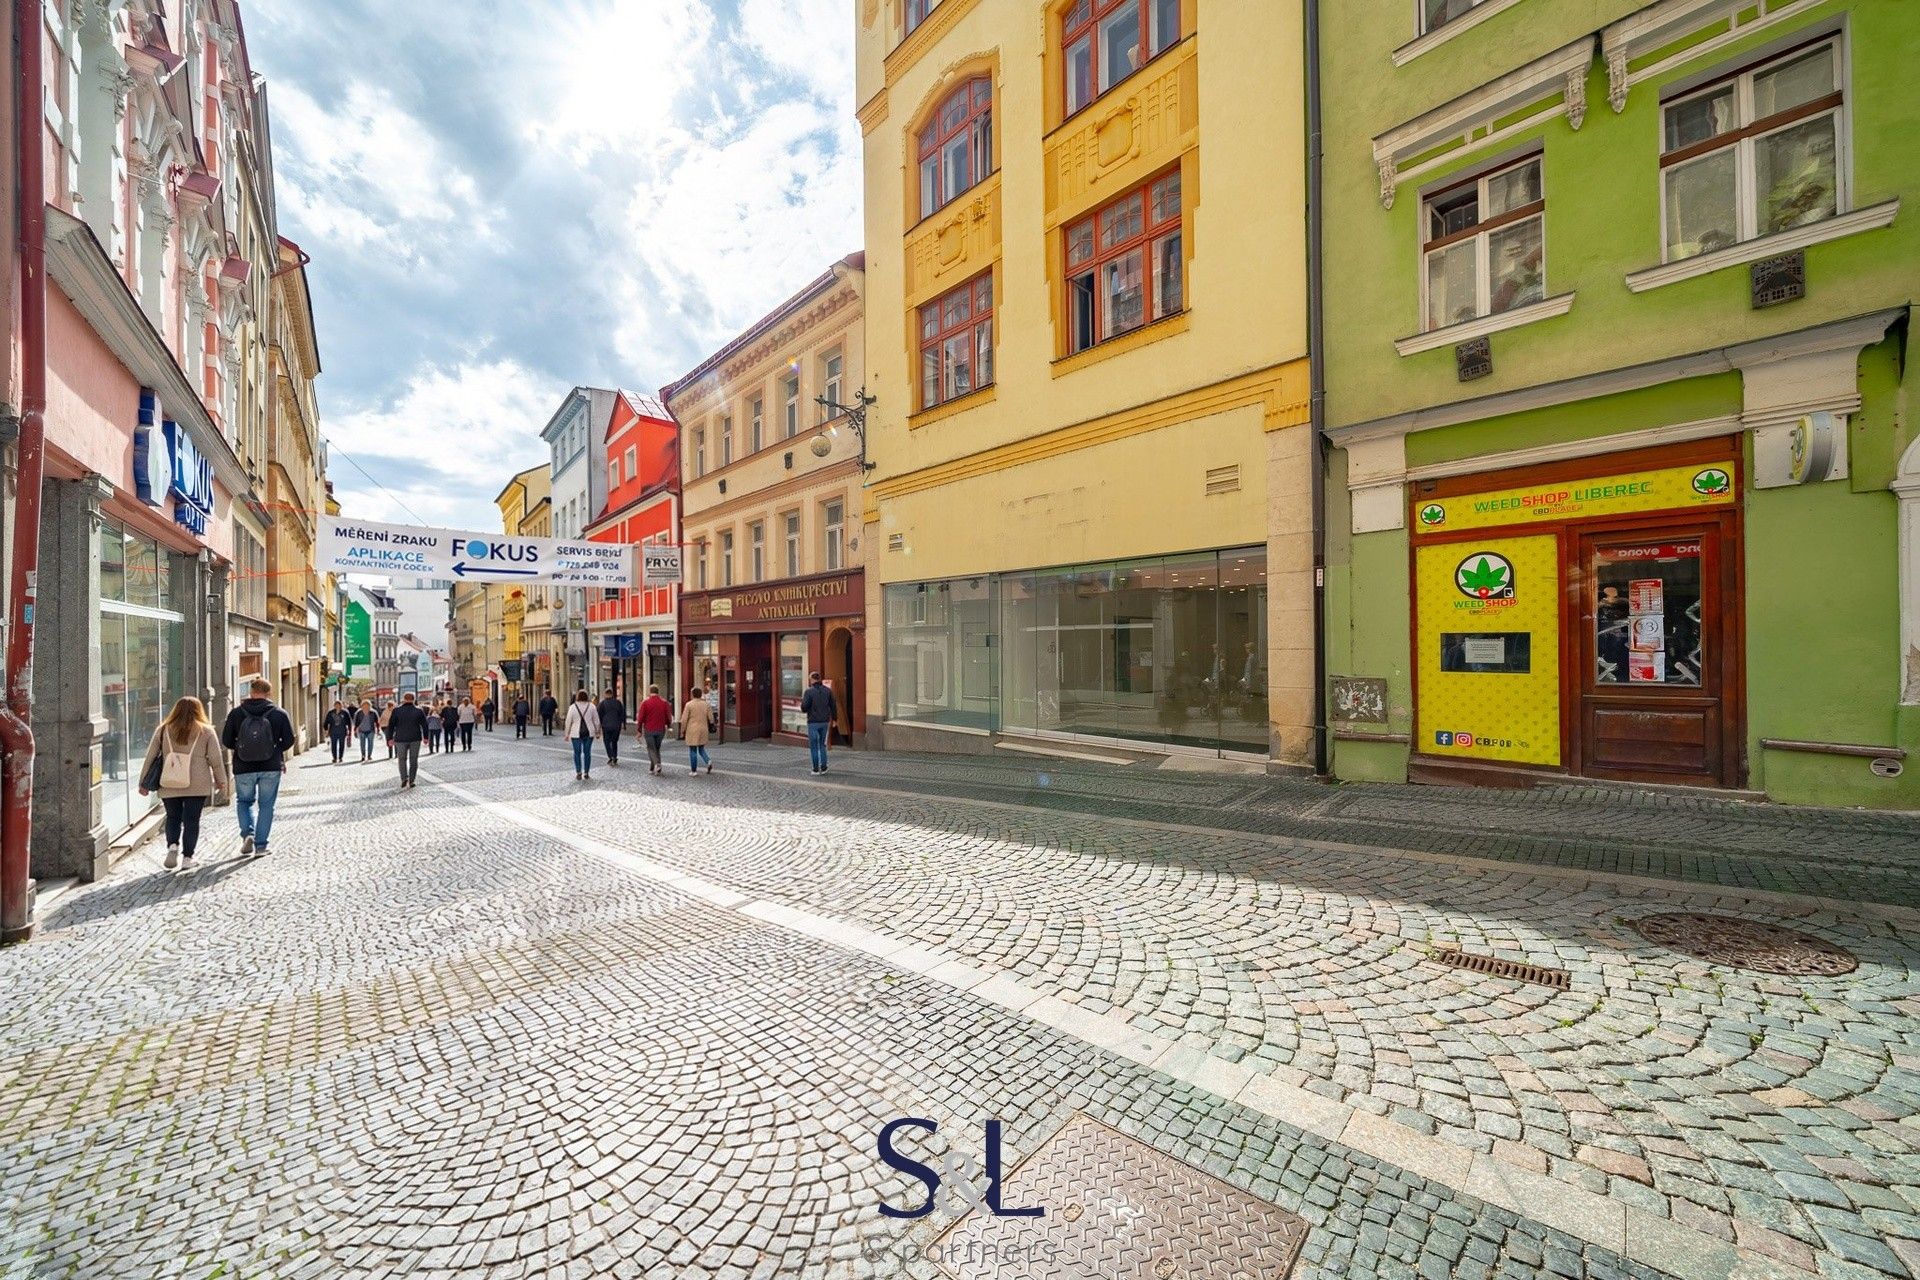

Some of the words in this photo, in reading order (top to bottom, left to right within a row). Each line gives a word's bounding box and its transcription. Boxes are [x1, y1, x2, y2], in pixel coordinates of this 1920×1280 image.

[175, 421, 215, 515] FOKUS
[1474, 490, 1570, 512] WEEDSHOP
[1574, 481, 1654, 501] LIBEREC
[335, 527, 389, 542] MĚŘENÍ
[392, 534, 438, 547] ZRAKU
[347, 547, 424, 563] APLIKACE
[452, 539, 539, 562] FOKUS
[556, 546, 592, 557] SERVIS
[1453, 598, 1519, 608] WEEDSHOP
